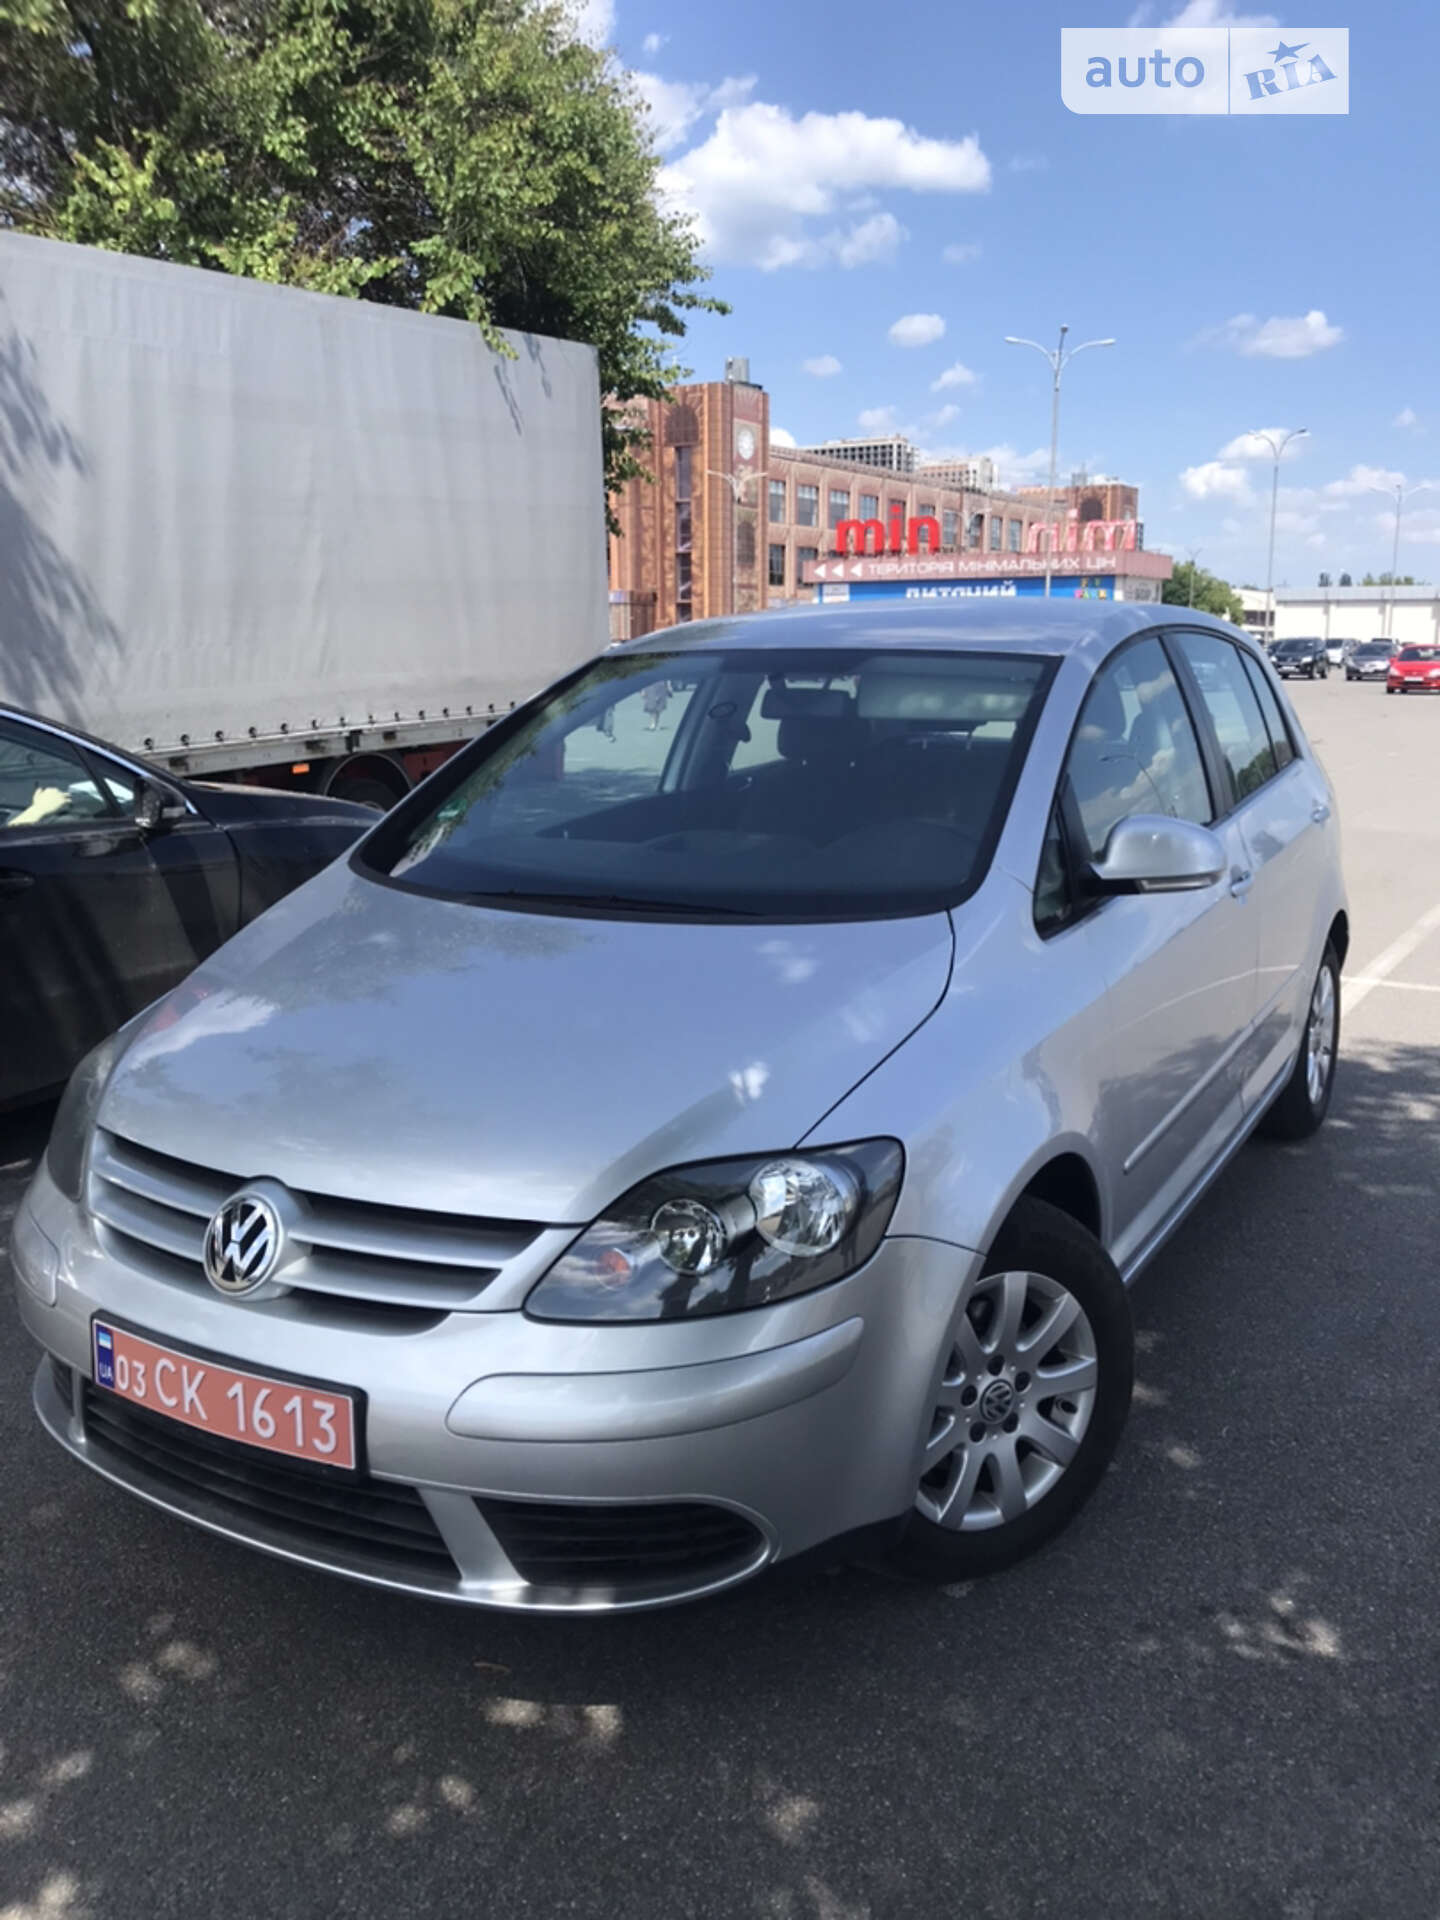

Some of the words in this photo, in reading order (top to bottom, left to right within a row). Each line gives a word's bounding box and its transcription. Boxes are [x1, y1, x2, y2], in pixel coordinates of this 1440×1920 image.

[836, 504, 939, 555] min
[116, 1356, 147, 1398] 03
[154, 1358, 208, 1421] CK
[226, 1381, 336, 1454] 1613
